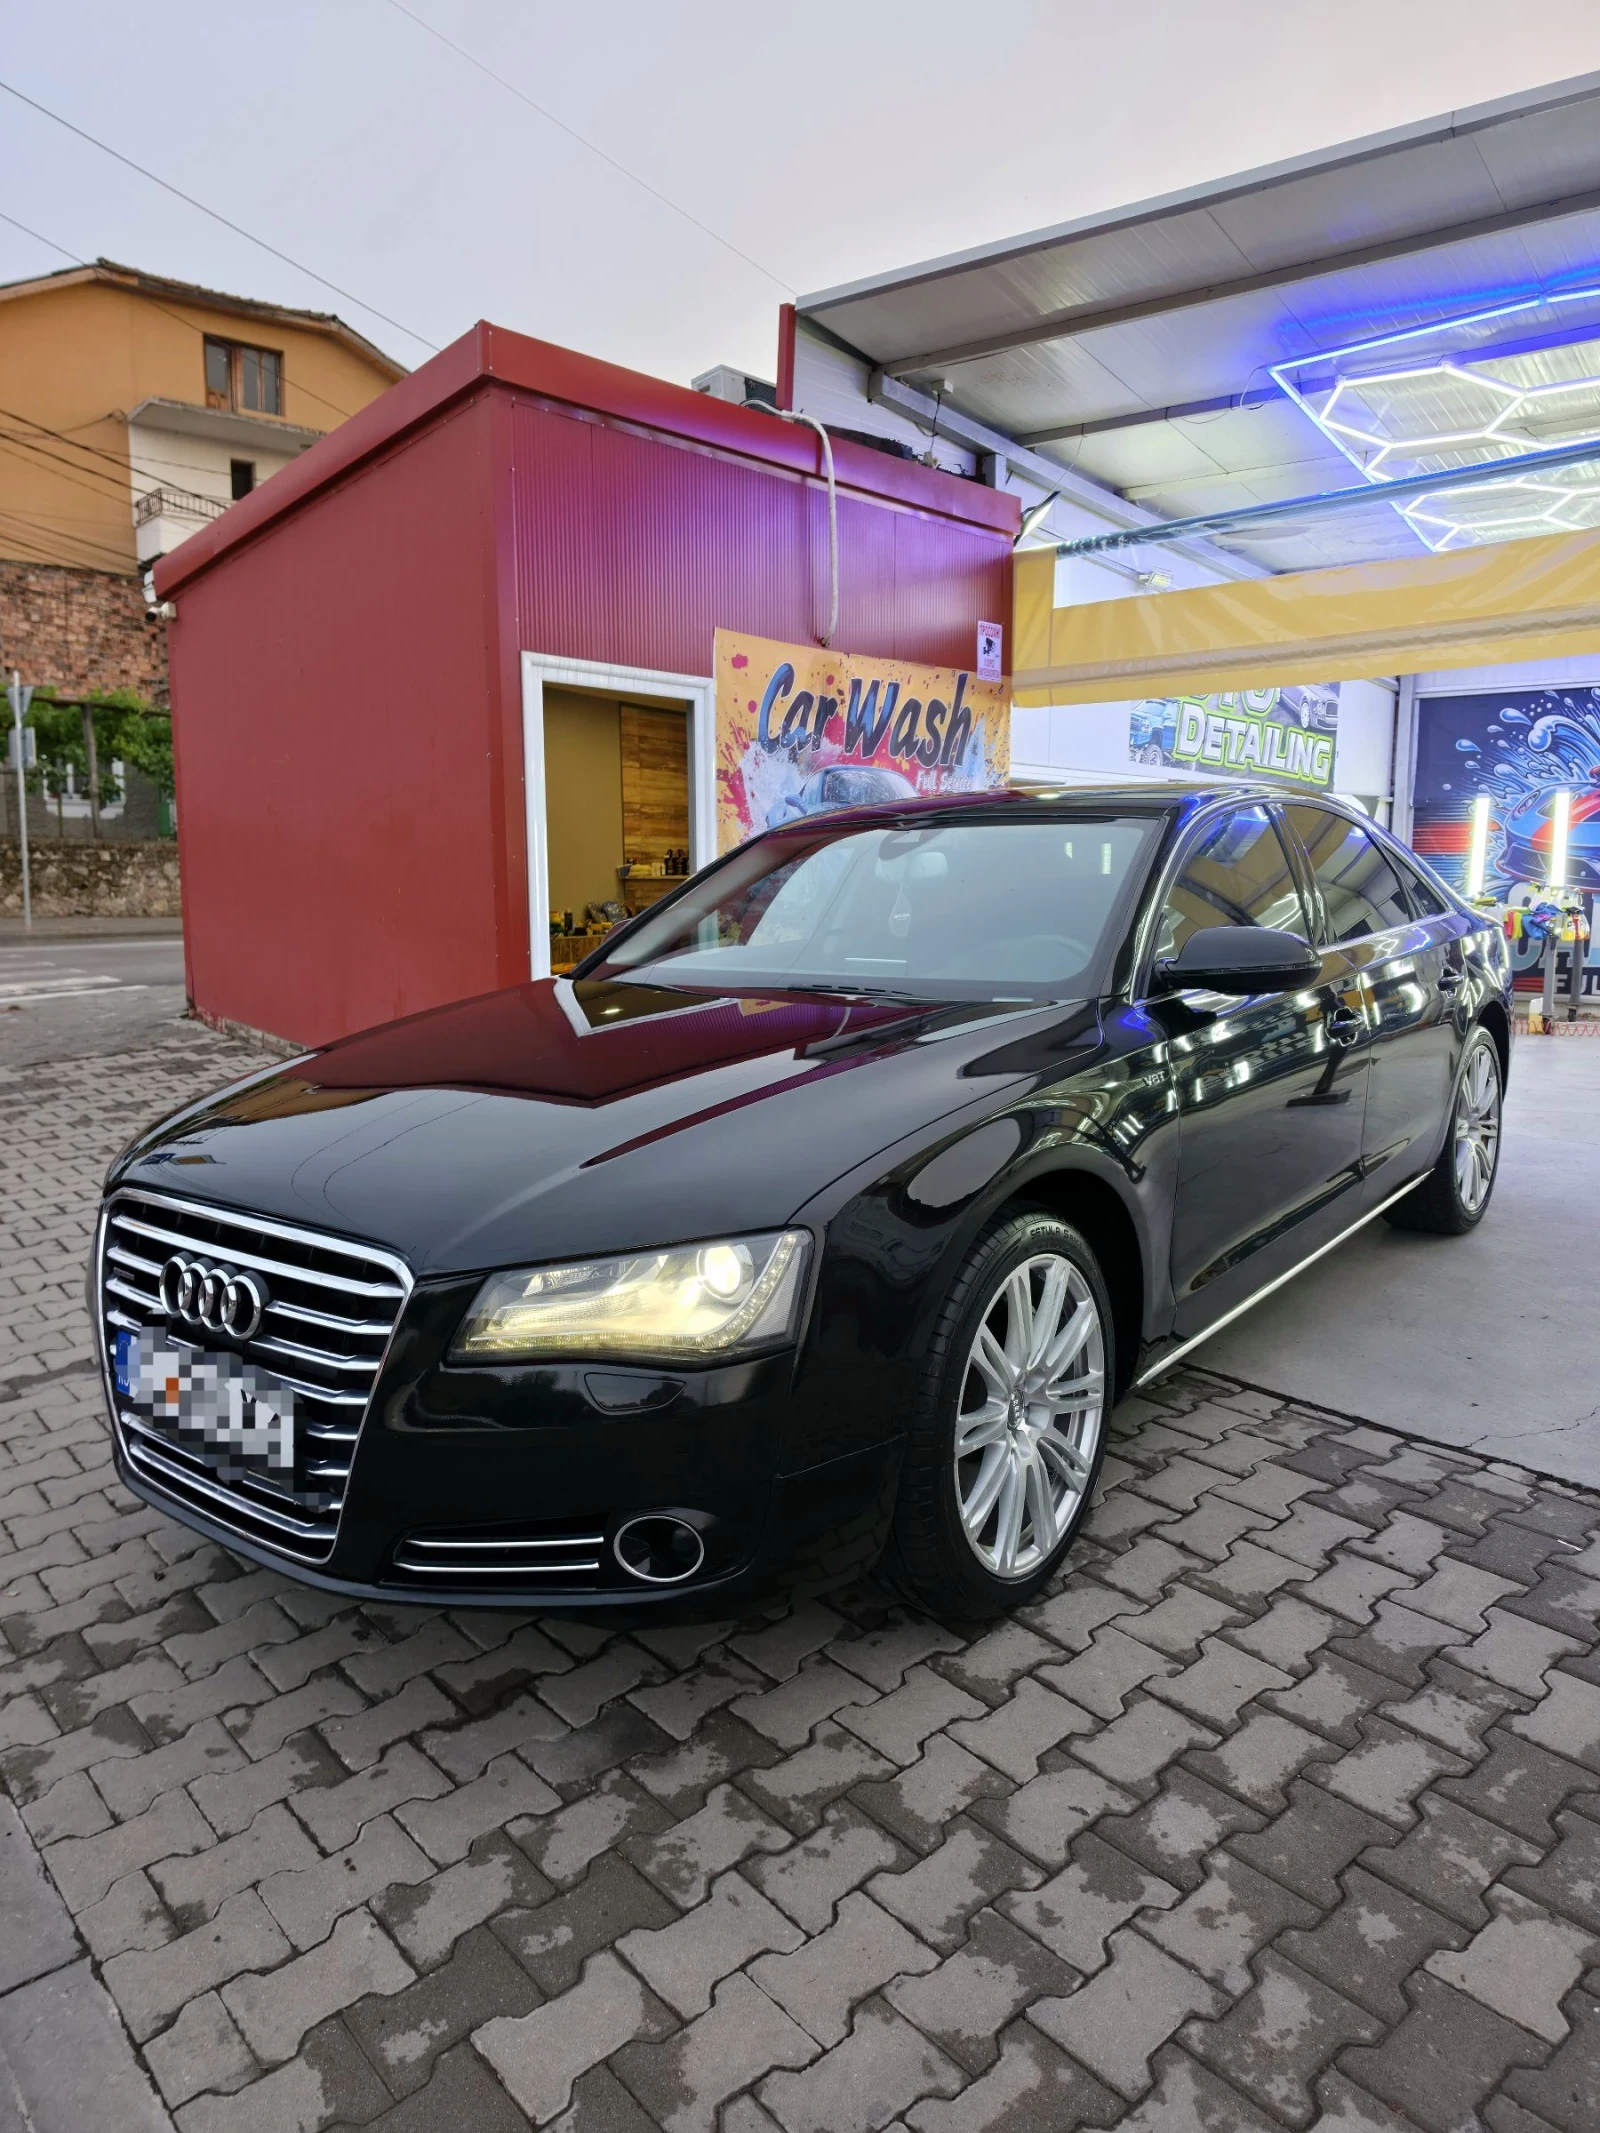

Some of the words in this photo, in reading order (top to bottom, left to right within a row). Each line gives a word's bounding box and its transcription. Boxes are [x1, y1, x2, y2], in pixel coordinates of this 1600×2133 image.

[758, 662, 838, 754] Car
[844, 673, 972, 769] Wash
[1176, 701, 1331, 782] DETAILING
[915, 769, 938, 792] Full
